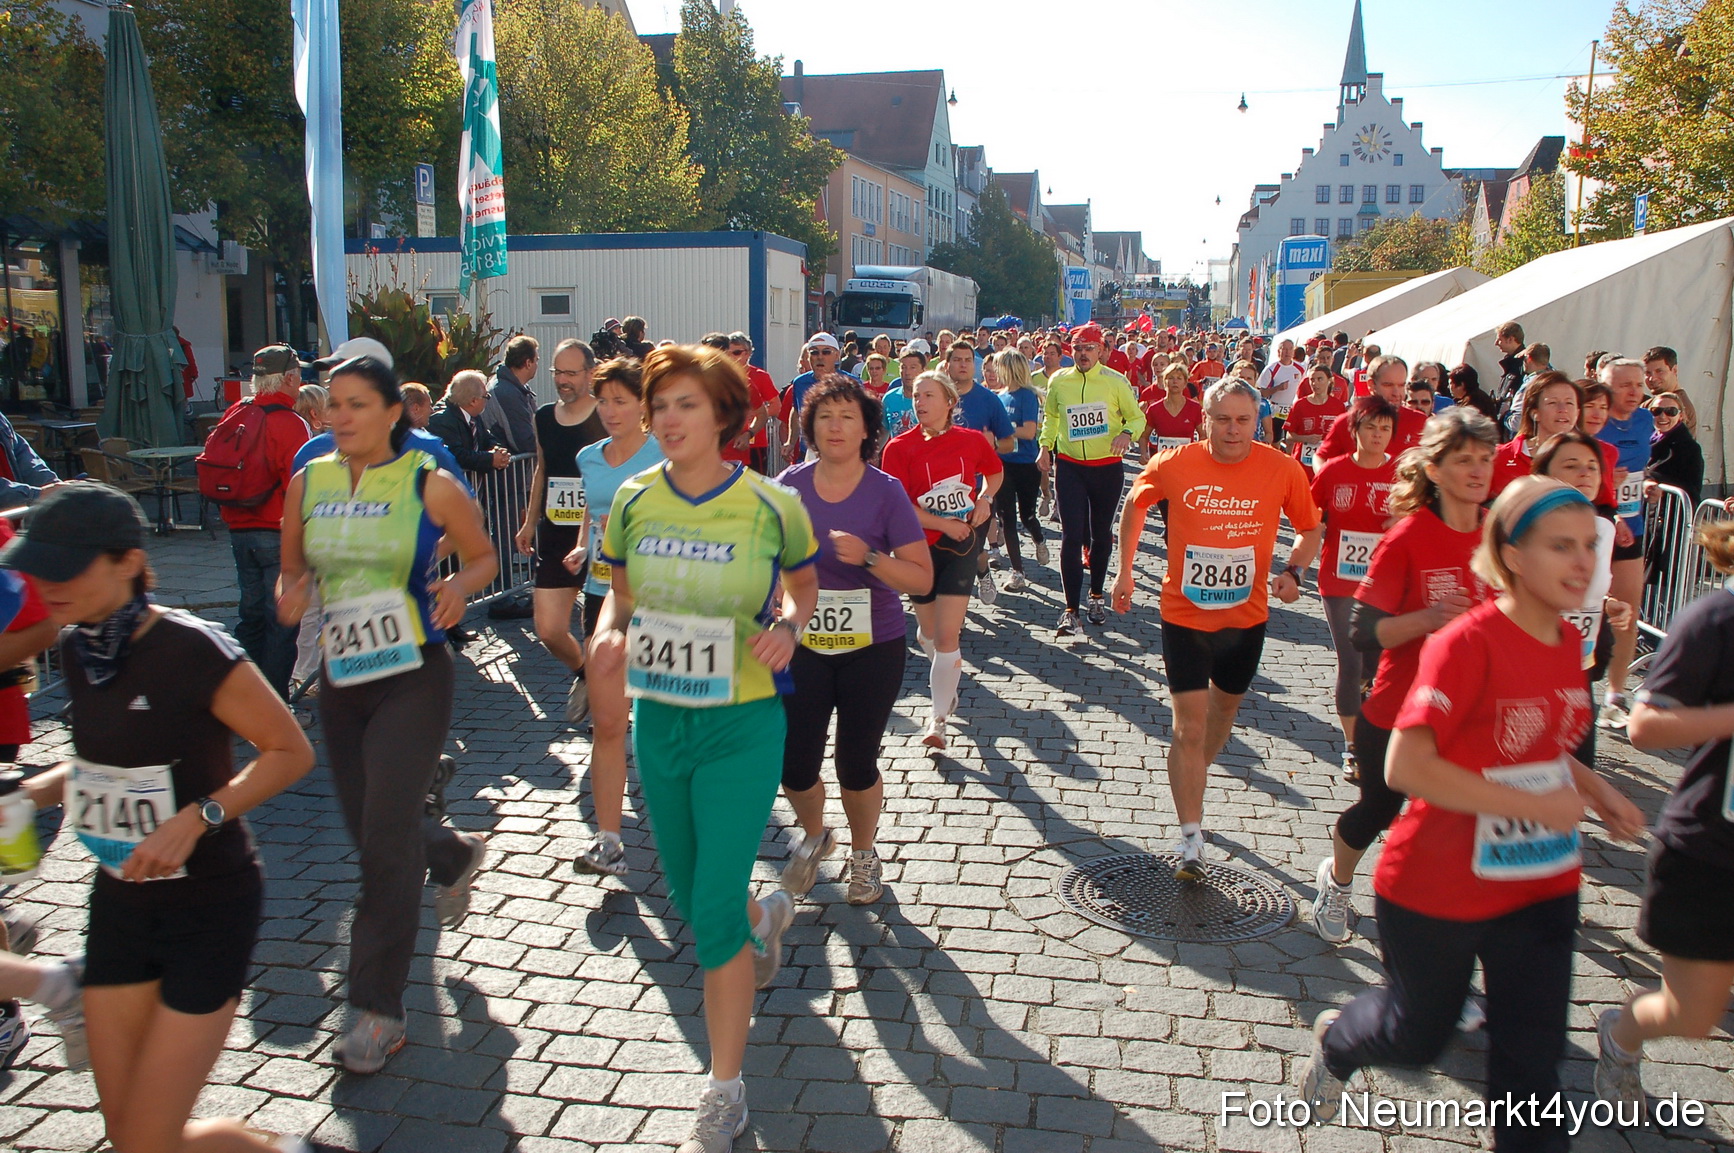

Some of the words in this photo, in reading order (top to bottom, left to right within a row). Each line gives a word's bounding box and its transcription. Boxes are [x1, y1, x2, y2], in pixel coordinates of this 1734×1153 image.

[419, 167, 430, 198] P
[1288, 244, 1324, 264] maxi
[1071, 411, 1104, 428] 3084
[1072, 425, 1105, 437] Christoph
[557, 490, 587, 508] 415
[925, 491, 966, 511] 2690
[1195, 493, 1259, 509] Fischer
[1200, 507, 1254, 516] AUTOMOBILE
[635, 534, 737, 563] BOCK
[1190, 562, 1247, 588] 2848
[1200, 588, 1235, 602] Erwin
[328, 614, 400, 655] 3410
[808, 633, 856, 650] Regina
[340, 648, 401, 677] Claudia
[637, 634, 715, 675] 3411
[646, 671, 710, 697] Miriam
[76, 788, 158, 837] 2140
